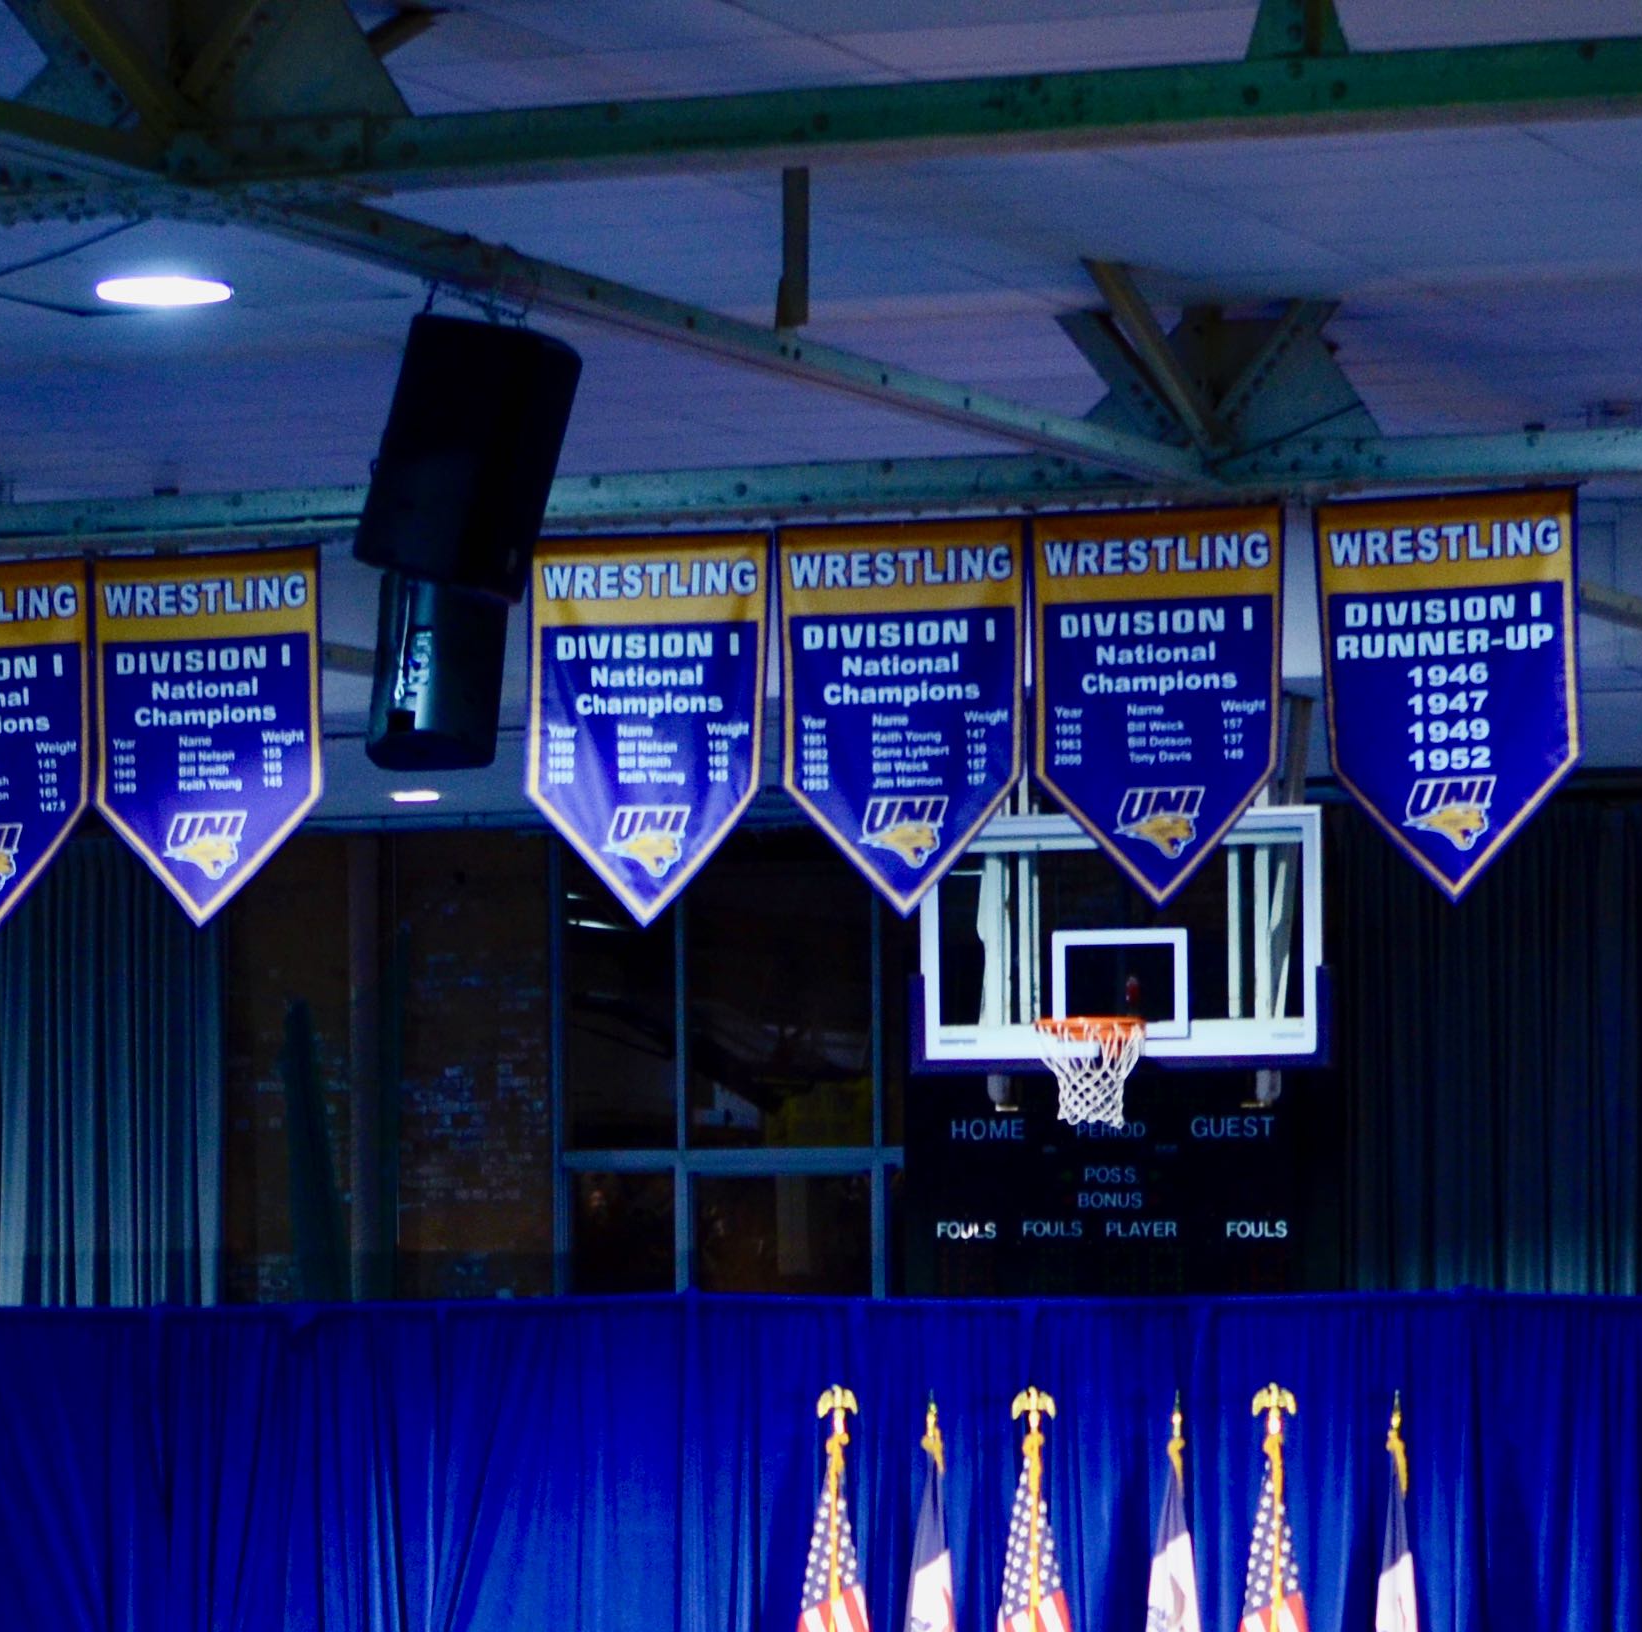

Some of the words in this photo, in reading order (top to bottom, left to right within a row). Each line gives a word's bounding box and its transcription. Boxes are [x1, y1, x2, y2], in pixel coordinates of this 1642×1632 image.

[1044, 531, 1270, 577] WRESTLING
[1329, 517, 1560, 567] WRESTLING
[789, 544, 1013, 589] WRESTLING
[543, 560, 756, 599] WRESTLING
[104, 573, 306, 617] WRESTLING
[1344, 595, 1516, 628] DIVISION
[1530, 592, 1541, 617] I
[803, 619, 967, 651] DIVISION
[986, 618, 995, 641] I
[1060, 608, 1226, 640] DIVISION
[1243, 606, 1252, 630] I
[557, 634, 712, 660] DIVISION
[730, 633, 739, 655] I
[1096, 642, 1217, 665] National
[1337, 624, 1554, 660] RUNNER-UP
[53, 653, 63, 676] I
[117, 645, 267, 675] DIVISION
[281, 644, 290, 666] I
[842, 653, 958, 677] National
[591, 666, 703, 688] National
[1082, 670, 1238, 695] Champions
[1408, 664, 1488, 688] 1946
[152, 678, 258, 700] National
[824, 681, 980, 708] Champions
[135, 703, 277, 728] Champions
[576, 692, 723, 718] Champions
[1055, 706, 1083, 718] Year
[1127, 704, 1164, 716] Name
[1221, 700, 1266, 714] Weight
[1408, 691, 1488, 716] 1947
[707, 722, 749, 738] Weight
[802, 715, 826, 729] Year
[872, 713, 908, 727] Name
[964, 709, 1007, 726] Weight
[1407, 719, 1490, 744] 1949
[35, 741, 76, 755] Weight
[113, 738, 135, 750] Year
[179, 736, 212, 748] Name
[261, 730, 304, 745] Weight
[1407, 747, 1491, 772] 1952
[1117, 786, 1205, 828] UNI
[1406, 775, 1497, 818] UNI
[609, 805, 691, 847] UNI
[863, 796, 948, 836] UNI
[167, 809, 247, 850] UNI
[952, 1119, 1025, 1141] HOME
[1076, 1122, 1145, 1137] PERIOD
[1191, 1117, 1275, 1137] GUEST
[1078, 1193, 1142, 1209] BONUS
[937, 1222, 997, 1239] FOULS
[1022, 1221, 1083, 1237] FOULS
[1106, 1222, 1176, 1237] PLAYER
[1226, 1221, 1287, 1238] FOULS
